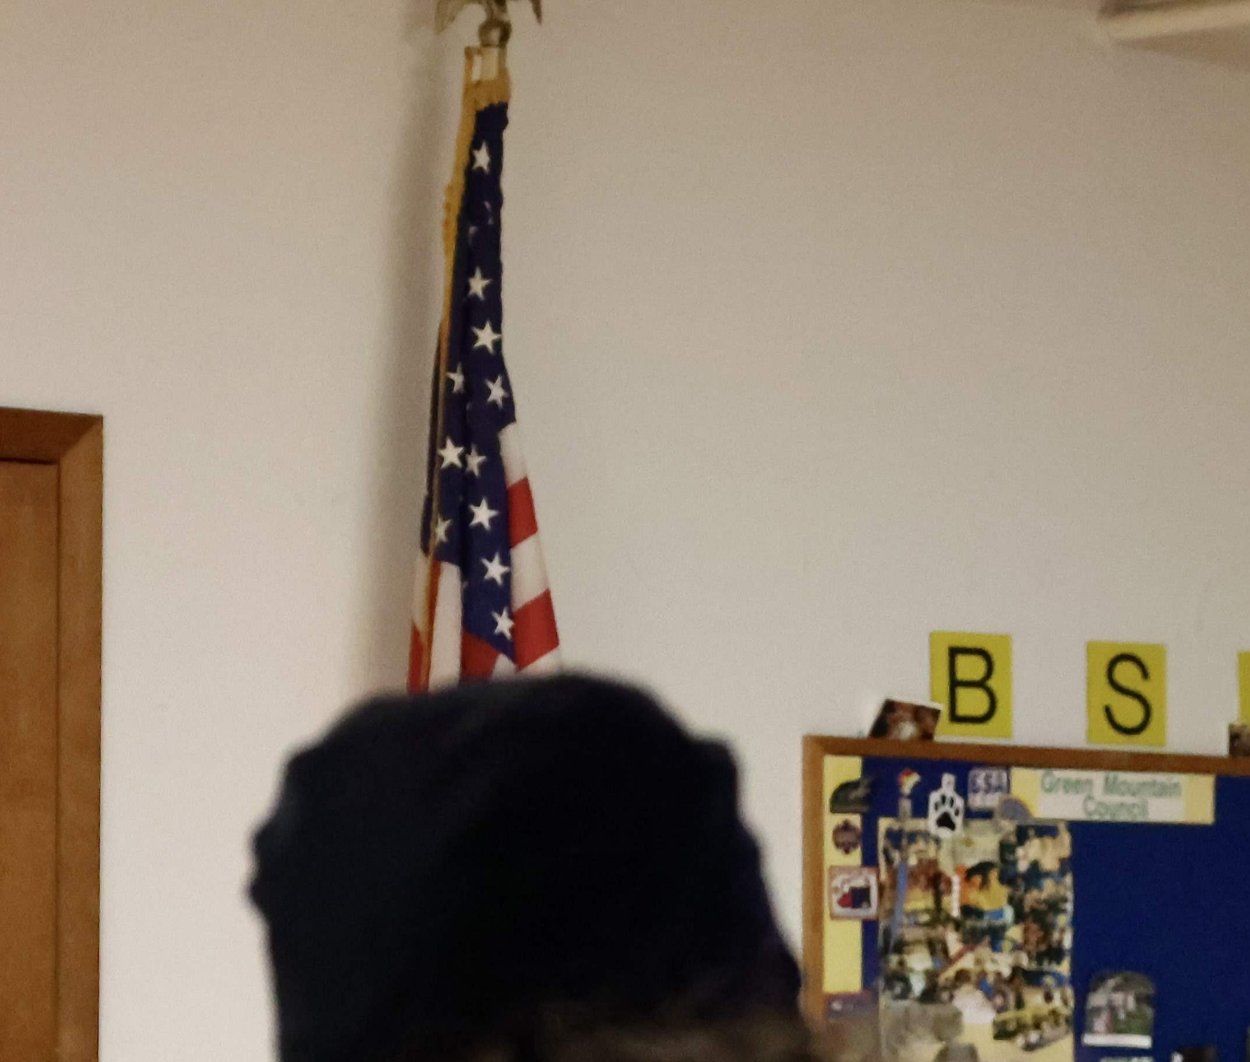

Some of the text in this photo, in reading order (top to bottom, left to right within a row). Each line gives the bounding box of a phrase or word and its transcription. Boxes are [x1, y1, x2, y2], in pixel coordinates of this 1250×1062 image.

[948, 646, 997, 724] B
[1104, 652, 1152, 736] S
[1040, 769, 1182, 798] Green Mountain
[1082, 794, 1150, 821] Council
